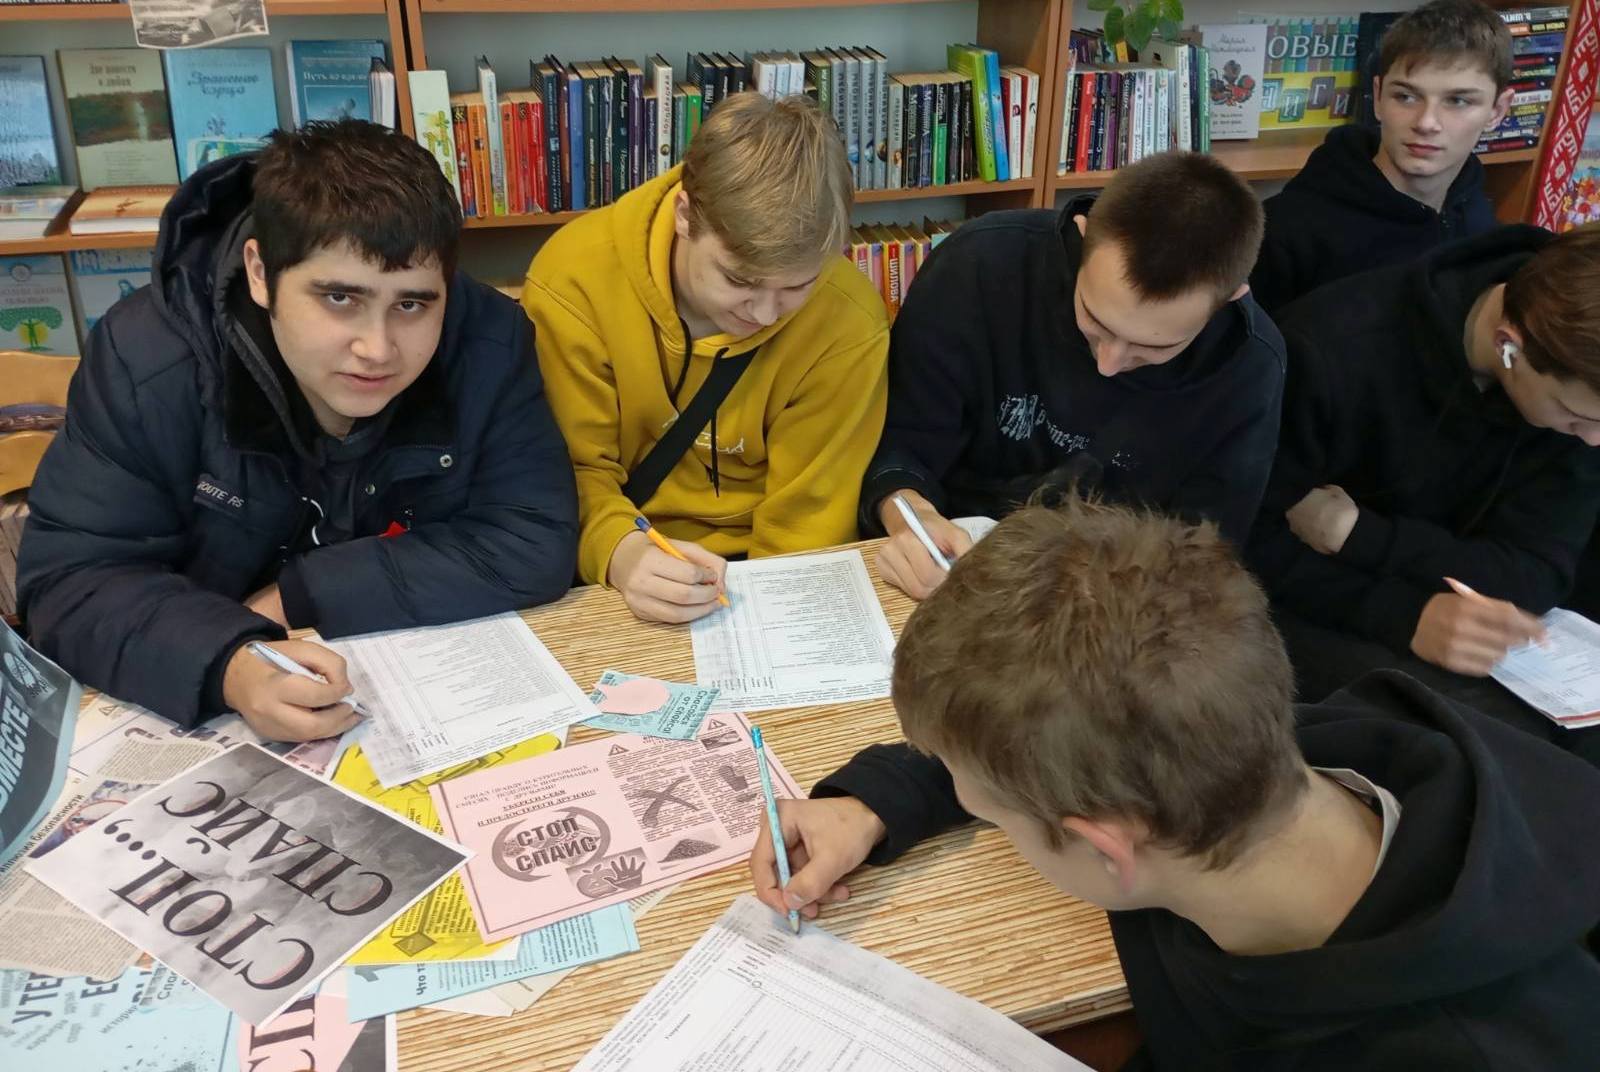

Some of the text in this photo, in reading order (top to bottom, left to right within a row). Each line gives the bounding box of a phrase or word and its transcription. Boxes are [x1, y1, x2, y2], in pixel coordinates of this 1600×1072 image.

[1268, 34, 1359, 58] ОВЫЕ
[1263, 81, 1351, 118] НИГИ
[889, 257, 900, 303] ШИЛОВА
[227, 495, 245, 508] RS
[30, 794, 85, 841] безопасности
[516, 817, 579, 847] СТОП
[156, 781, 393, 916] СПАЙС
[416, 973, 427, 997] Что
[12, 1010, 52, 1024] У
